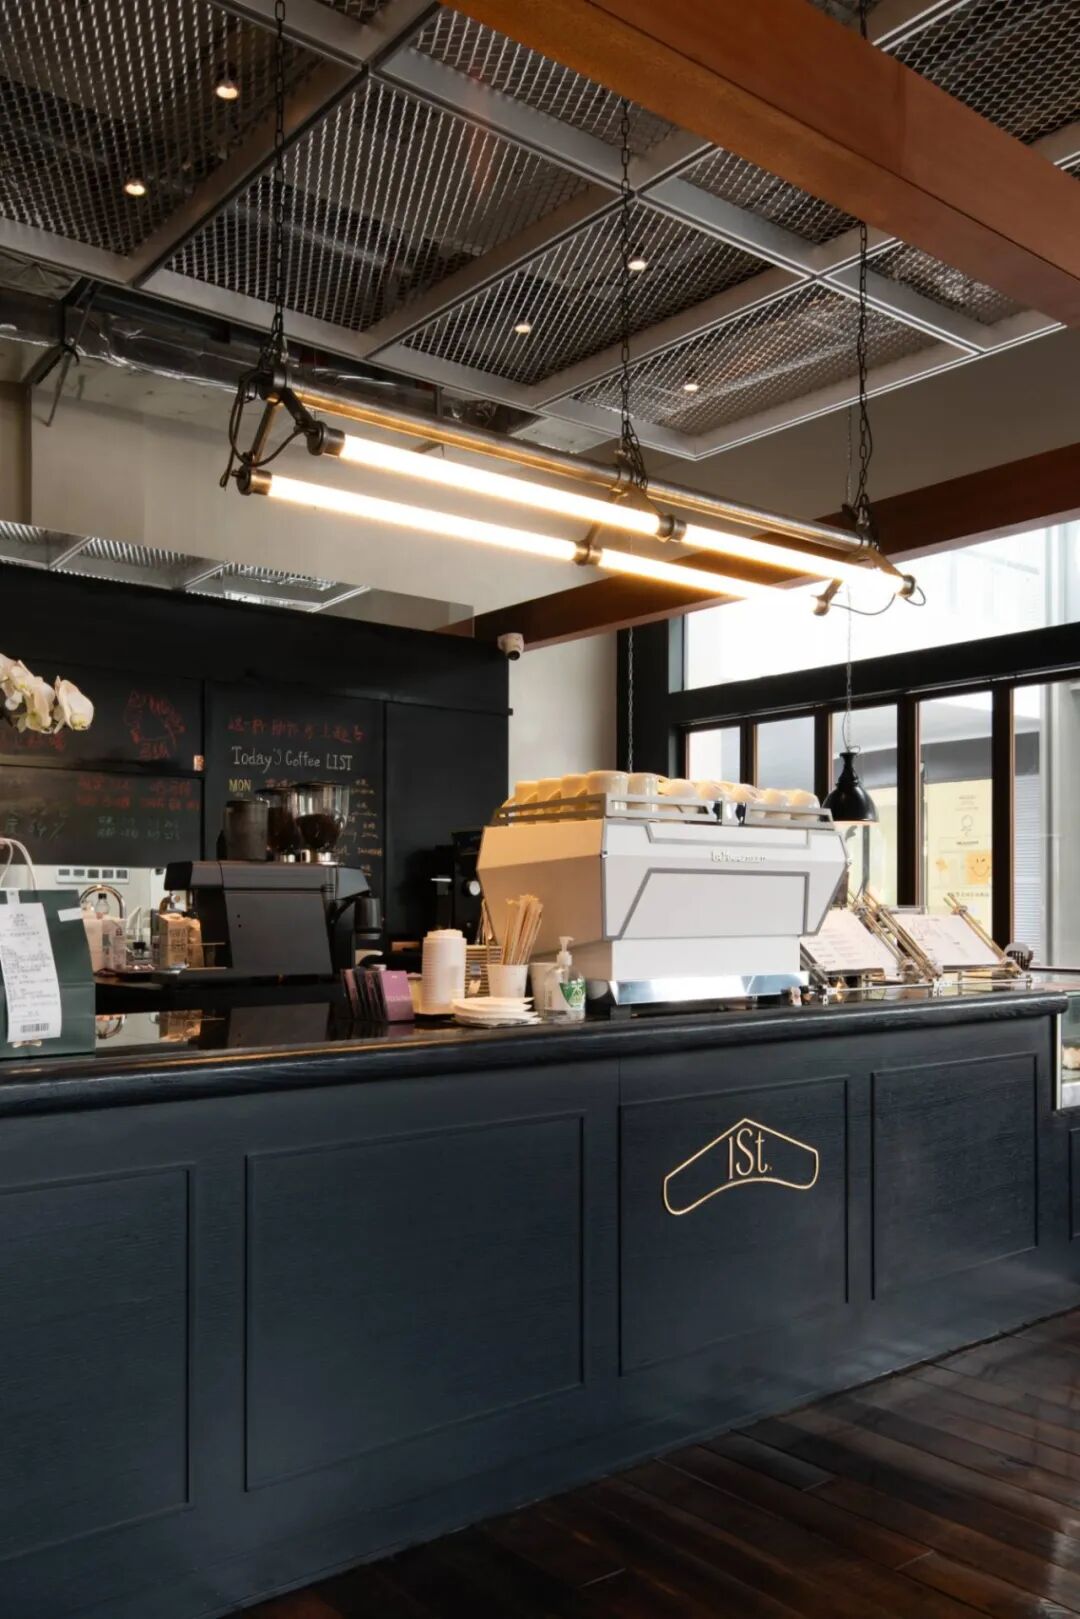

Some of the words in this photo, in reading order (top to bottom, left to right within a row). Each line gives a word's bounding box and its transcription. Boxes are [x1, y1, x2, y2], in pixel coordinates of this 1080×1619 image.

[285, 751, 321, 768] Coffee
[326, 753, 353, 771] LIST
[228, 779, 252, 793] MON
